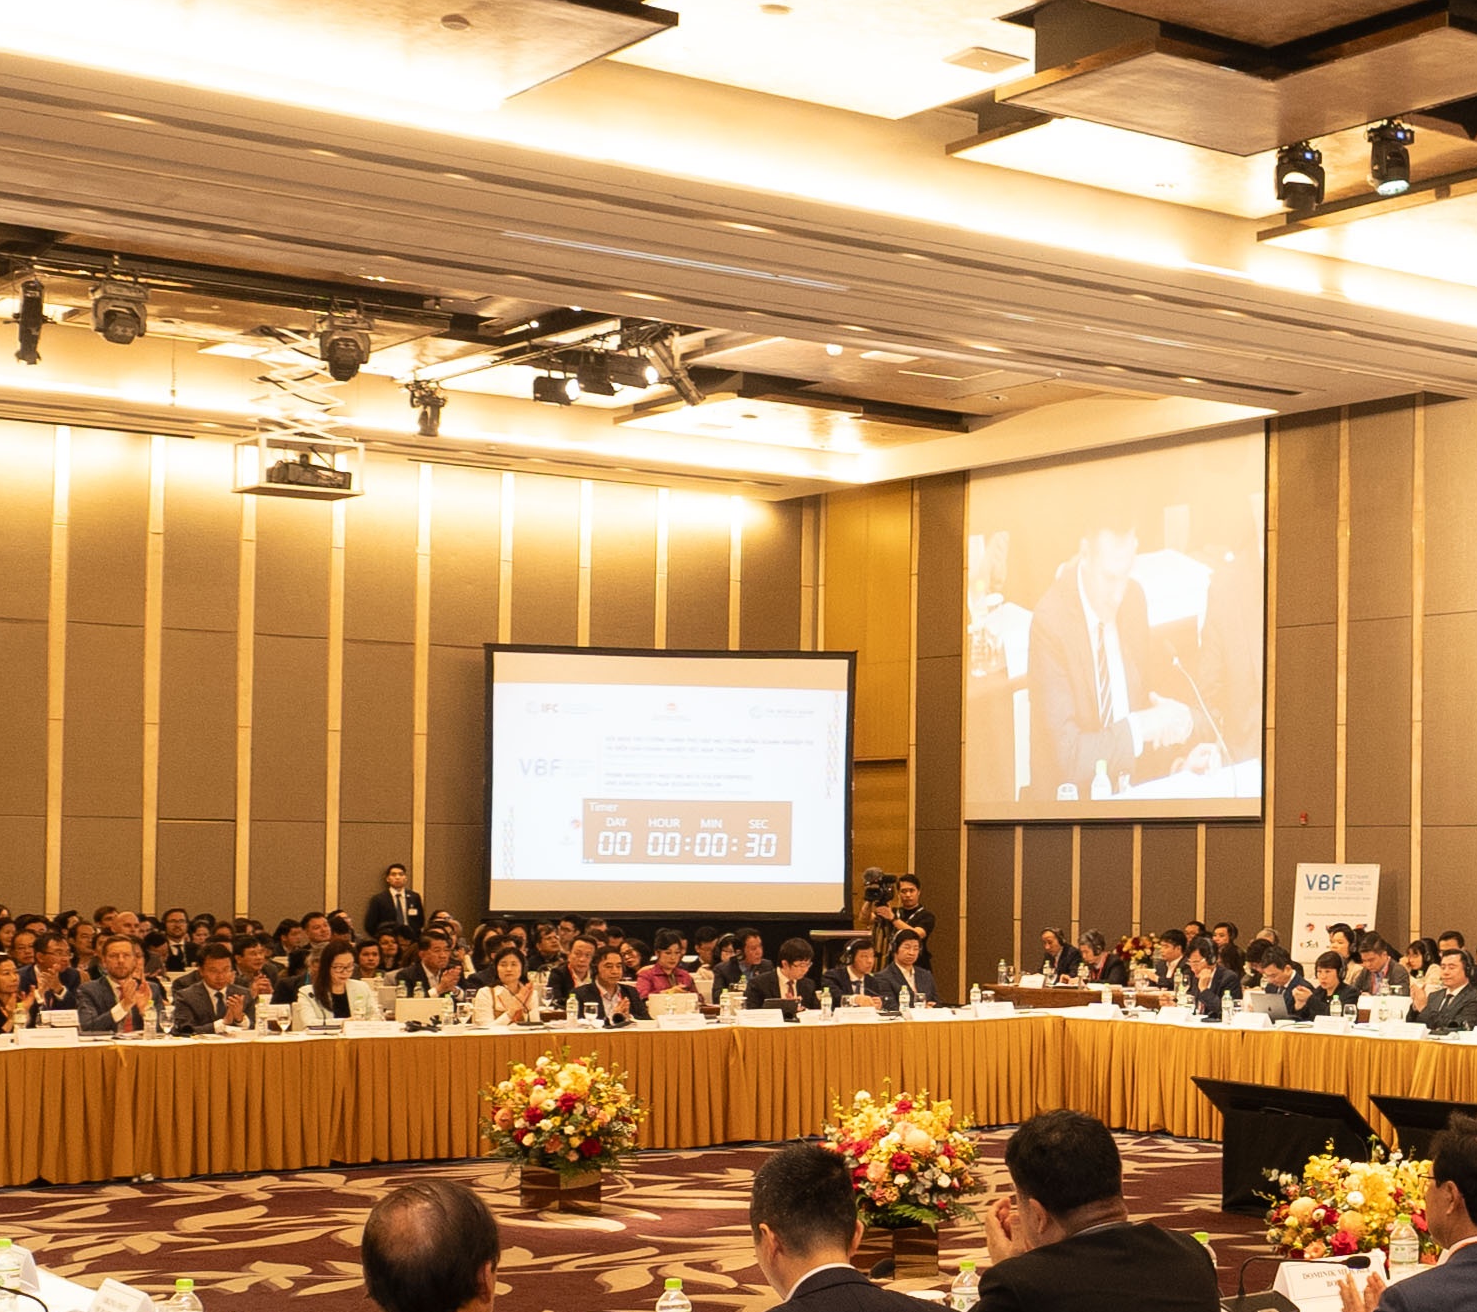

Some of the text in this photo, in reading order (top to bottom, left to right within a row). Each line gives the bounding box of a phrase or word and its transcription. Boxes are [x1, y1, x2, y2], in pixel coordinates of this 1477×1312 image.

[541, 704, 559, 713] IFC
[519, 758, 562, 776] VBF
[589, 802, 618, 812] Timer
[606, 818, 769, 829] DAY HOUR MIN SEC
[598, 831, 632, 856] 00
[1306, 874, 1343, 891] VBF
[1303, 1271, 1336, 1279] DOMINIK
